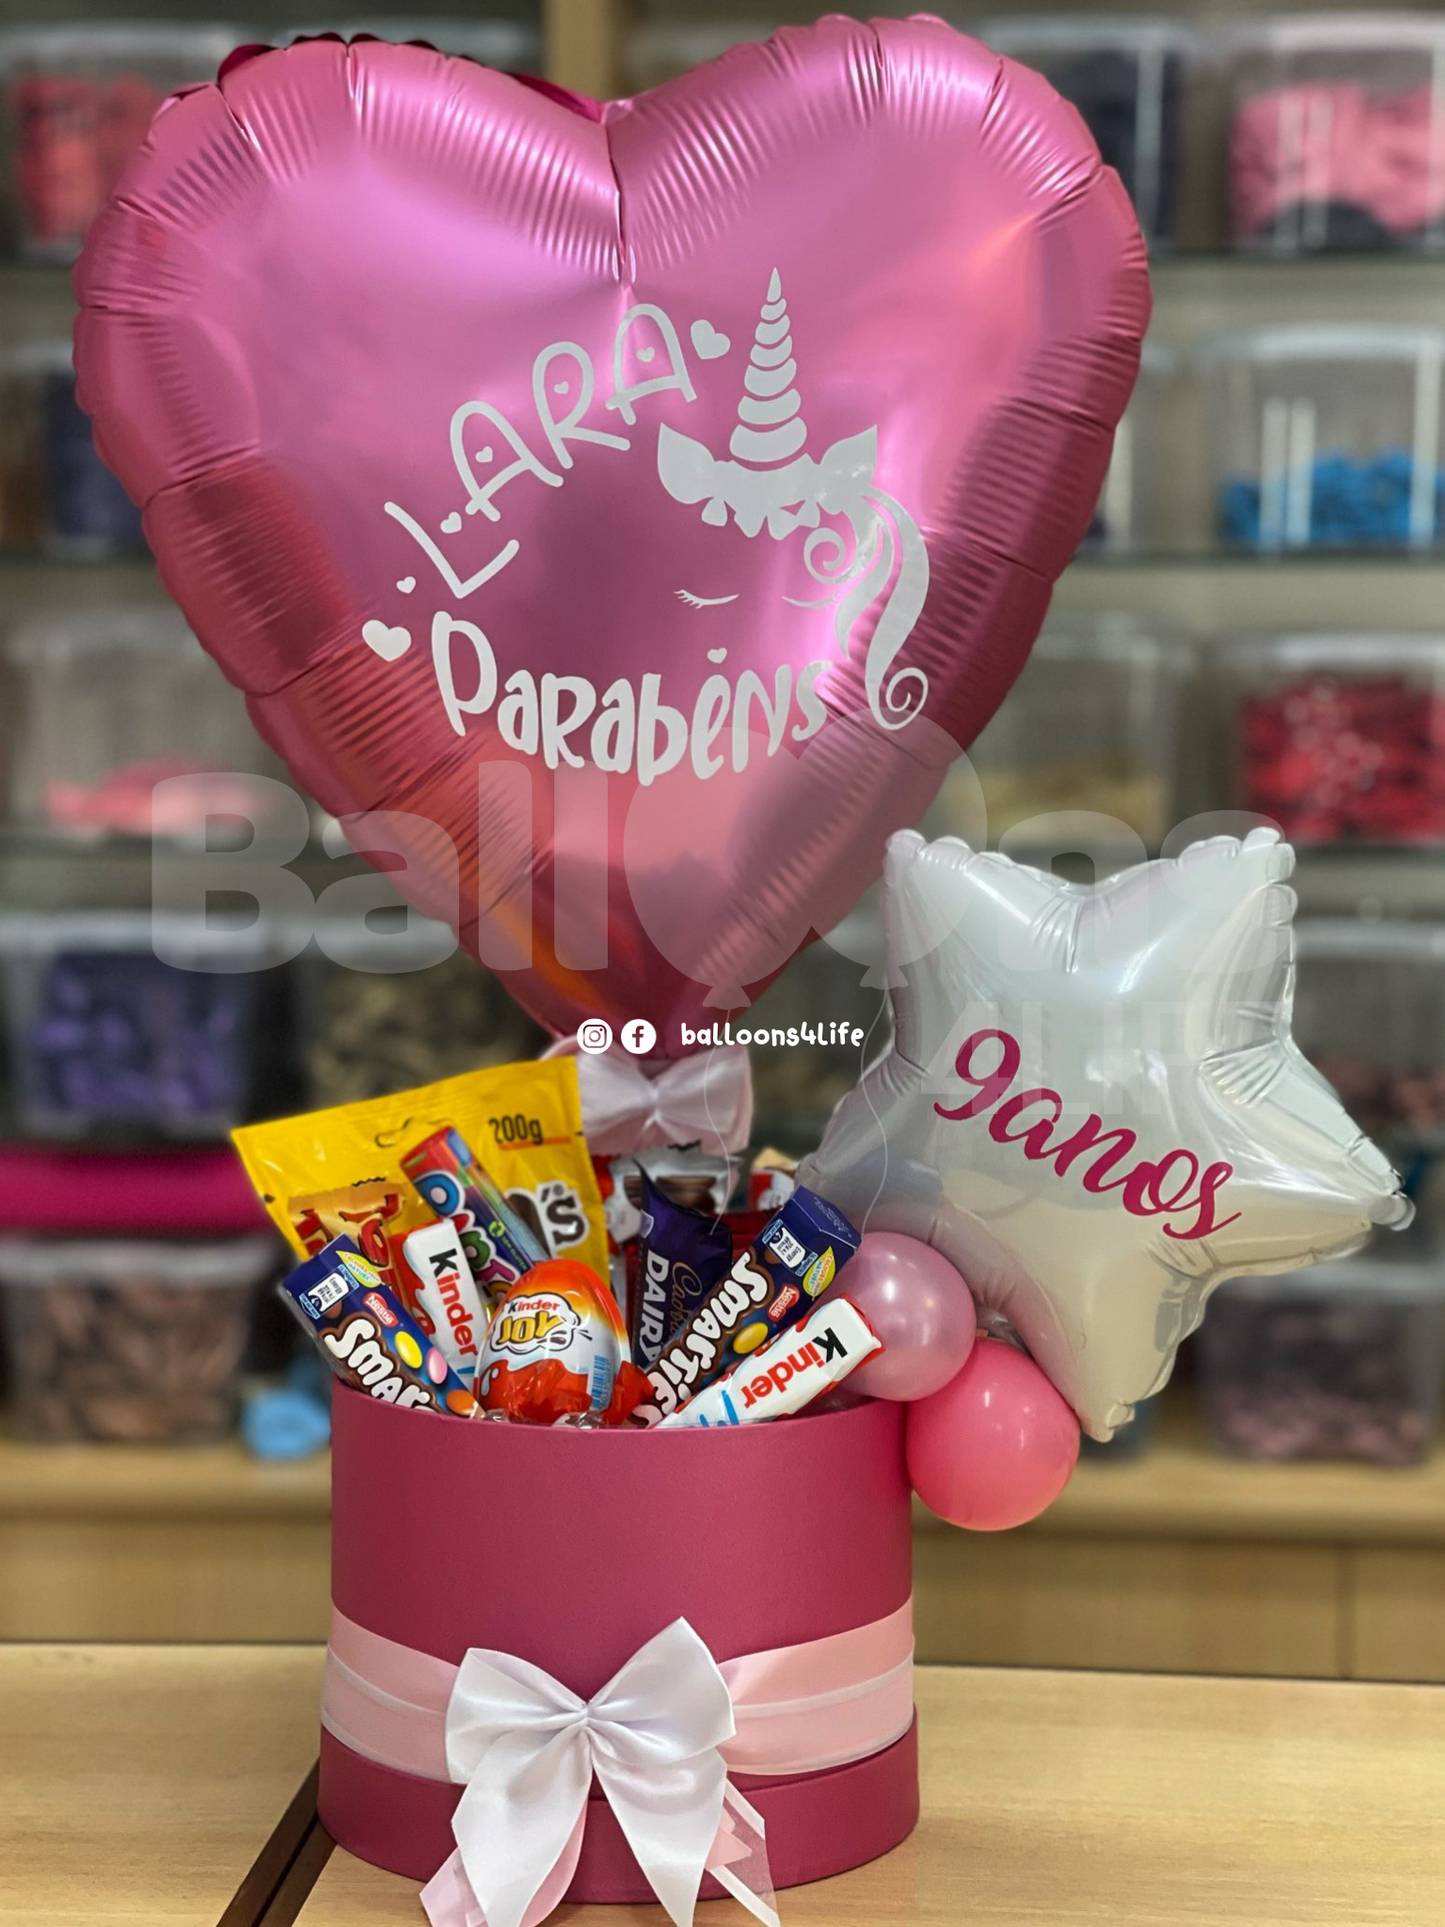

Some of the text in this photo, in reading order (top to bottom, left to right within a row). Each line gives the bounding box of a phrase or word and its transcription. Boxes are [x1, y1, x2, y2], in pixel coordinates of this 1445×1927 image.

[383, 303, 698, 599] LARA
[489, 1114, 543, 1146] 200g
[429, 1248, 479, 1357] Kinder
[496, 1310, 567, 1345] JOY
[508, 1299, 561, 1313] Kinder
[769, 1286, 796, 1318] Nestlé
[324, 1318, 437, 1413] Smar
[740, 1327, 848, 1409] Kinder
